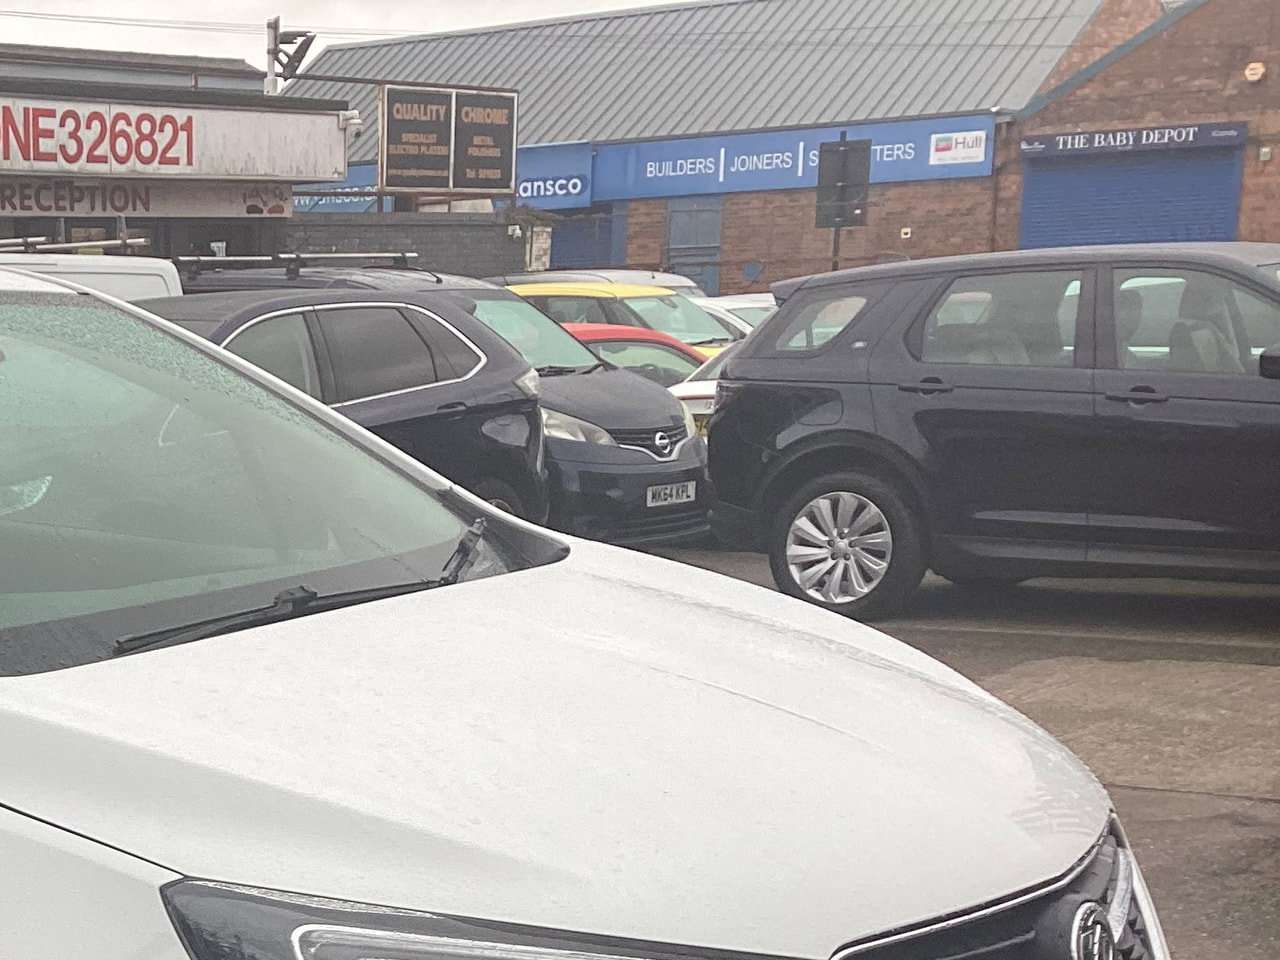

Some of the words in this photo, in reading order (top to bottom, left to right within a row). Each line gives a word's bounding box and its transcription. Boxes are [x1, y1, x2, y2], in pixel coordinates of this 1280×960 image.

[393, 103, 447, 122] QUALITY
[462, 106, 509, 125] CHROME
[954, 136, 983, 150] Hull
[1056, 134, 1090, 150] THE
[1094, 131, 1136, 148] BABY
[1142, 127, 1199, 145] DEPOT
[646, 158, 715, 178] BUILDERS
[730, 152, 793, 173] JOINERS
[0, 181, 151, 213] RECEPTION
[516, 177, 582, 197] ansco
